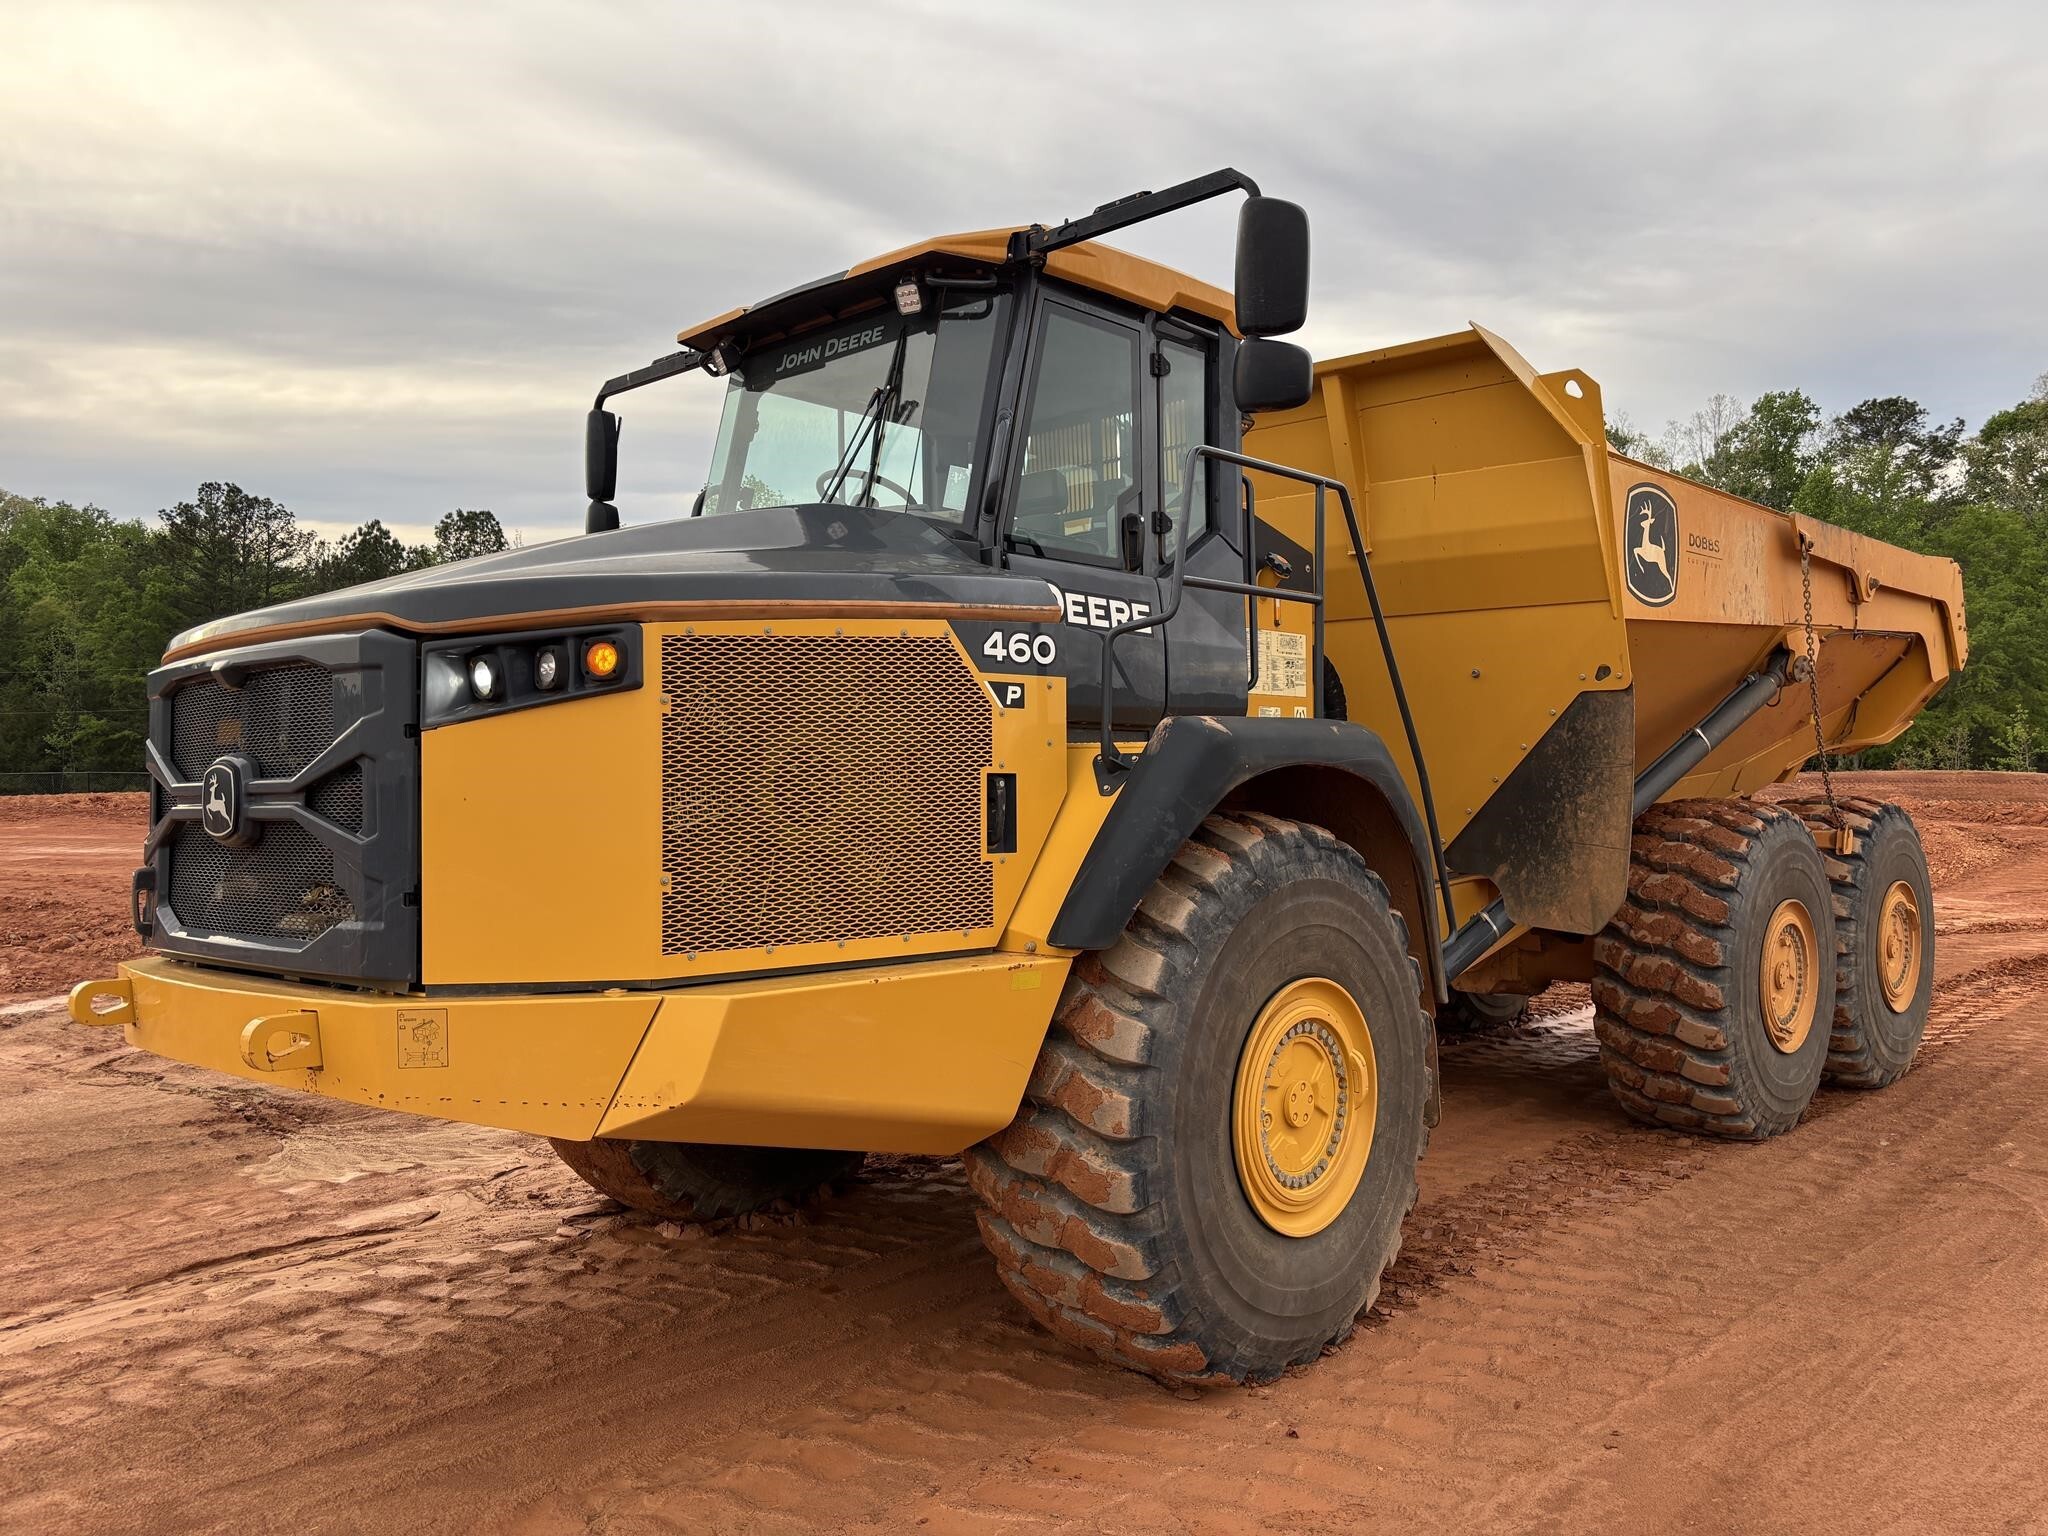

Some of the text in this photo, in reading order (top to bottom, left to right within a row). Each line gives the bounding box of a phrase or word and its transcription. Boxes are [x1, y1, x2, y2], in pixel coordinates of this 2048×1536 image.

[776, 325, 885, 372] JOHN DEERE
[983, 631, 1056, 665] 460
[1006, 685, 1022, 705] P
